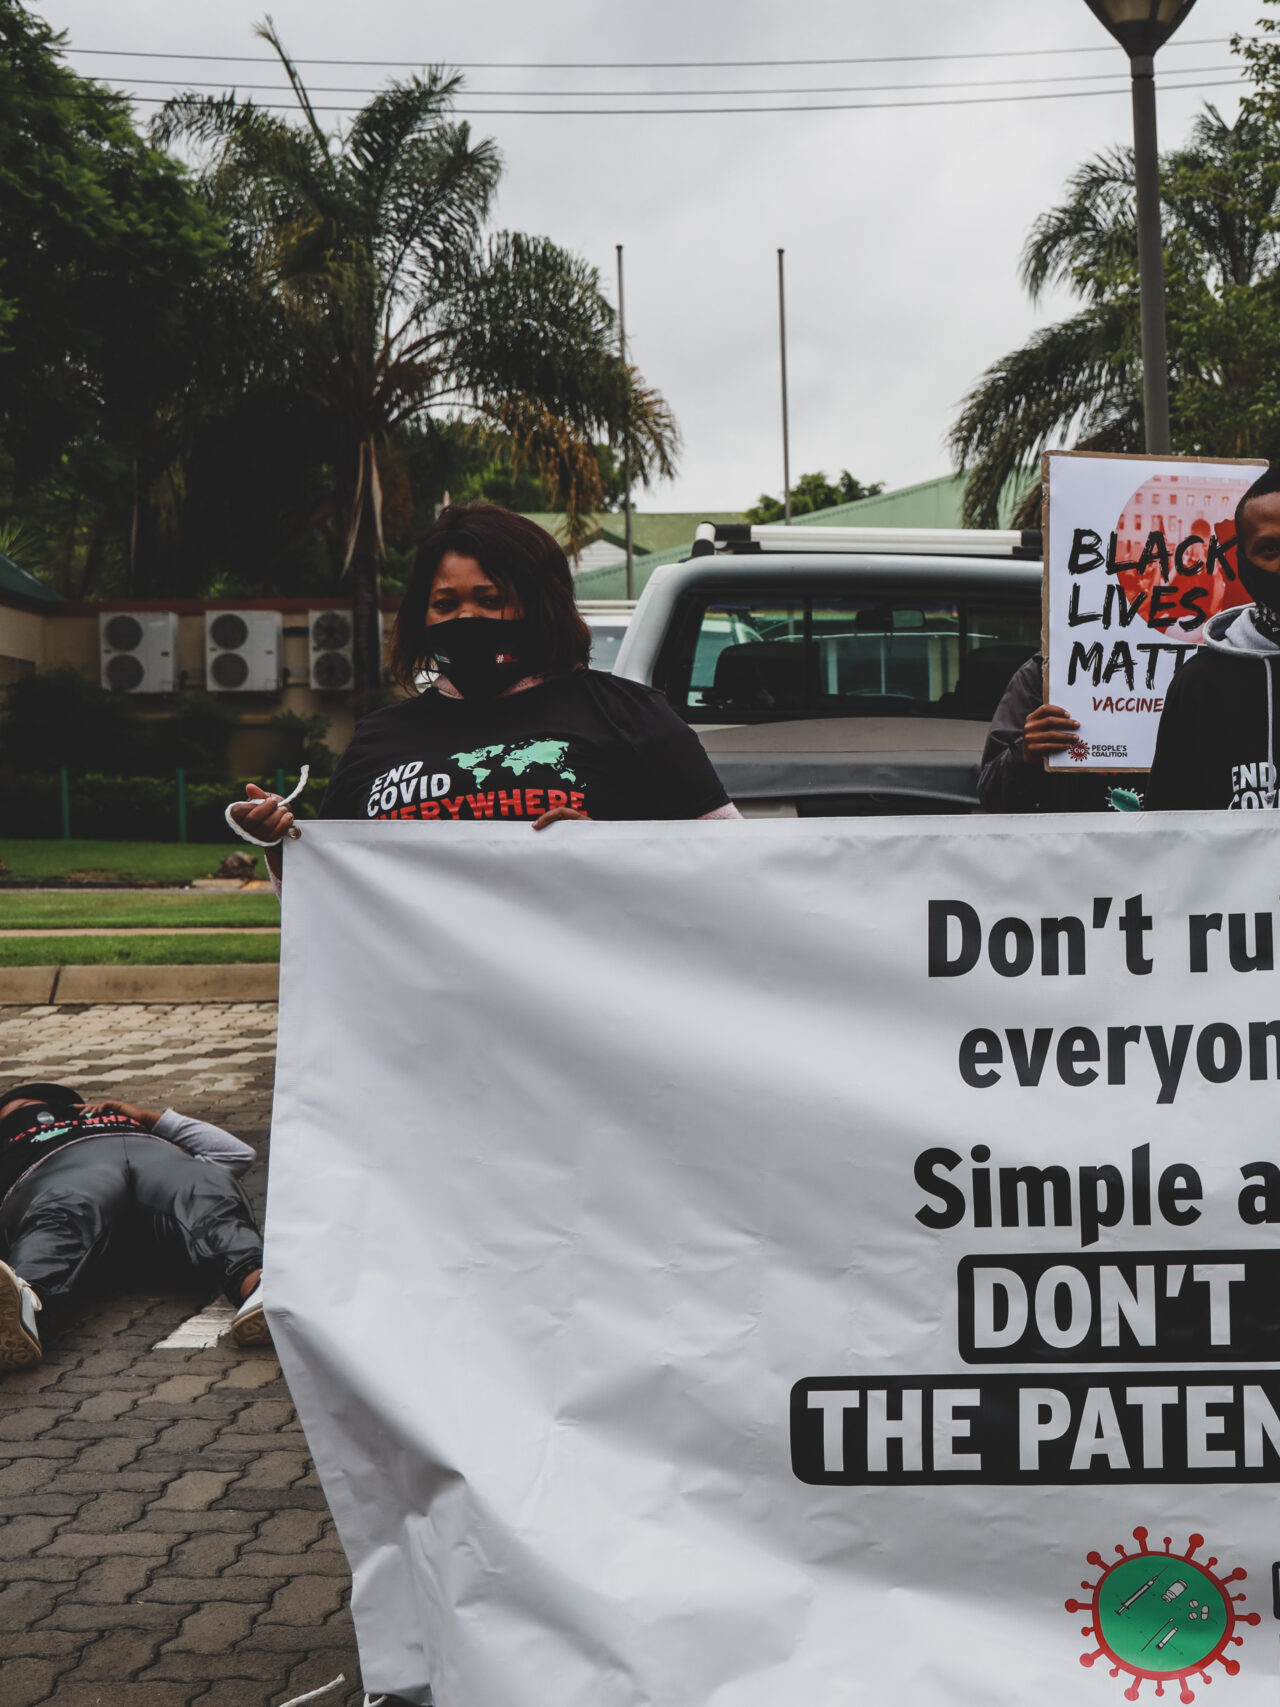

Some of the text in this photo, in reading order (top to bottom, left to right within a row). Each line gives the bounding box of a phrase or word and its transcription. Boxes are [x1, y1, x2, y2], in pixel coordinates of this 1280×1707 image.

[1068, 528, 1238, 583] BLACK
[1068, 583, 1209, 632] LIVES
[1067, 640, 1199, 692] MATT
[1092, 696, 1164, 714] VACCINE
[1091, 744, 1128, 752] PEOPLE'S
[367, 773, 451, 817] COVID
[370, 761, 424, 794] END
[1231, 761, 1277, 792] END
[927, 893, 1154, 978] Don't
[912, 1142, 1203, 1248] Simple
[972, 1262, 1245, 1349] DON'T
[806, 1386, 982, 1473] THE
